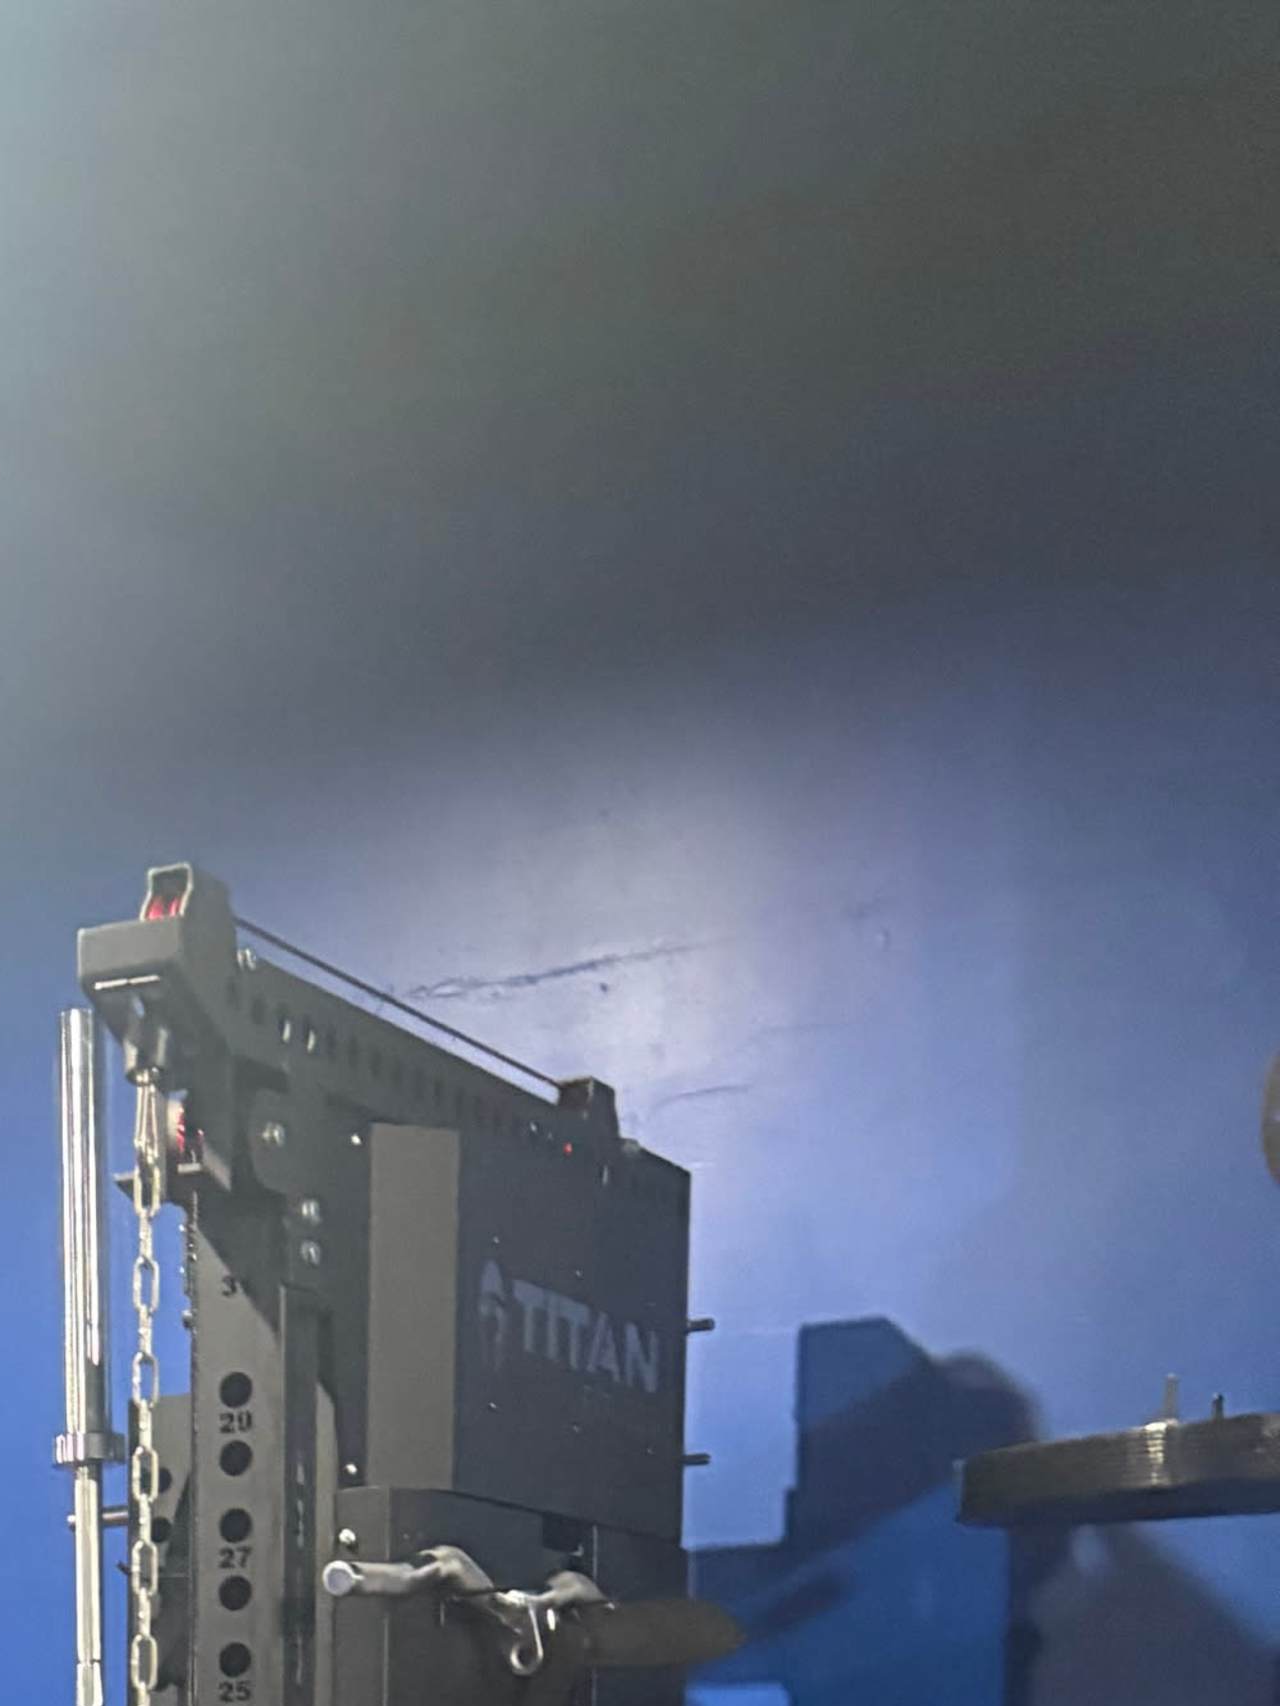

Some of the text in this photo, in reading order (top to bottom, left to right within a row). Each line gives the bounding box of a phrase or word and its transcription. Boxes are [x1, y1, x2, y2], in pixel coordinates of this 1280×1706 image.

[511, 1278, 659, 1393] TITAN
[218, 1546, 253, 1568] 27
[218, 1680, 251, 1702] 25
